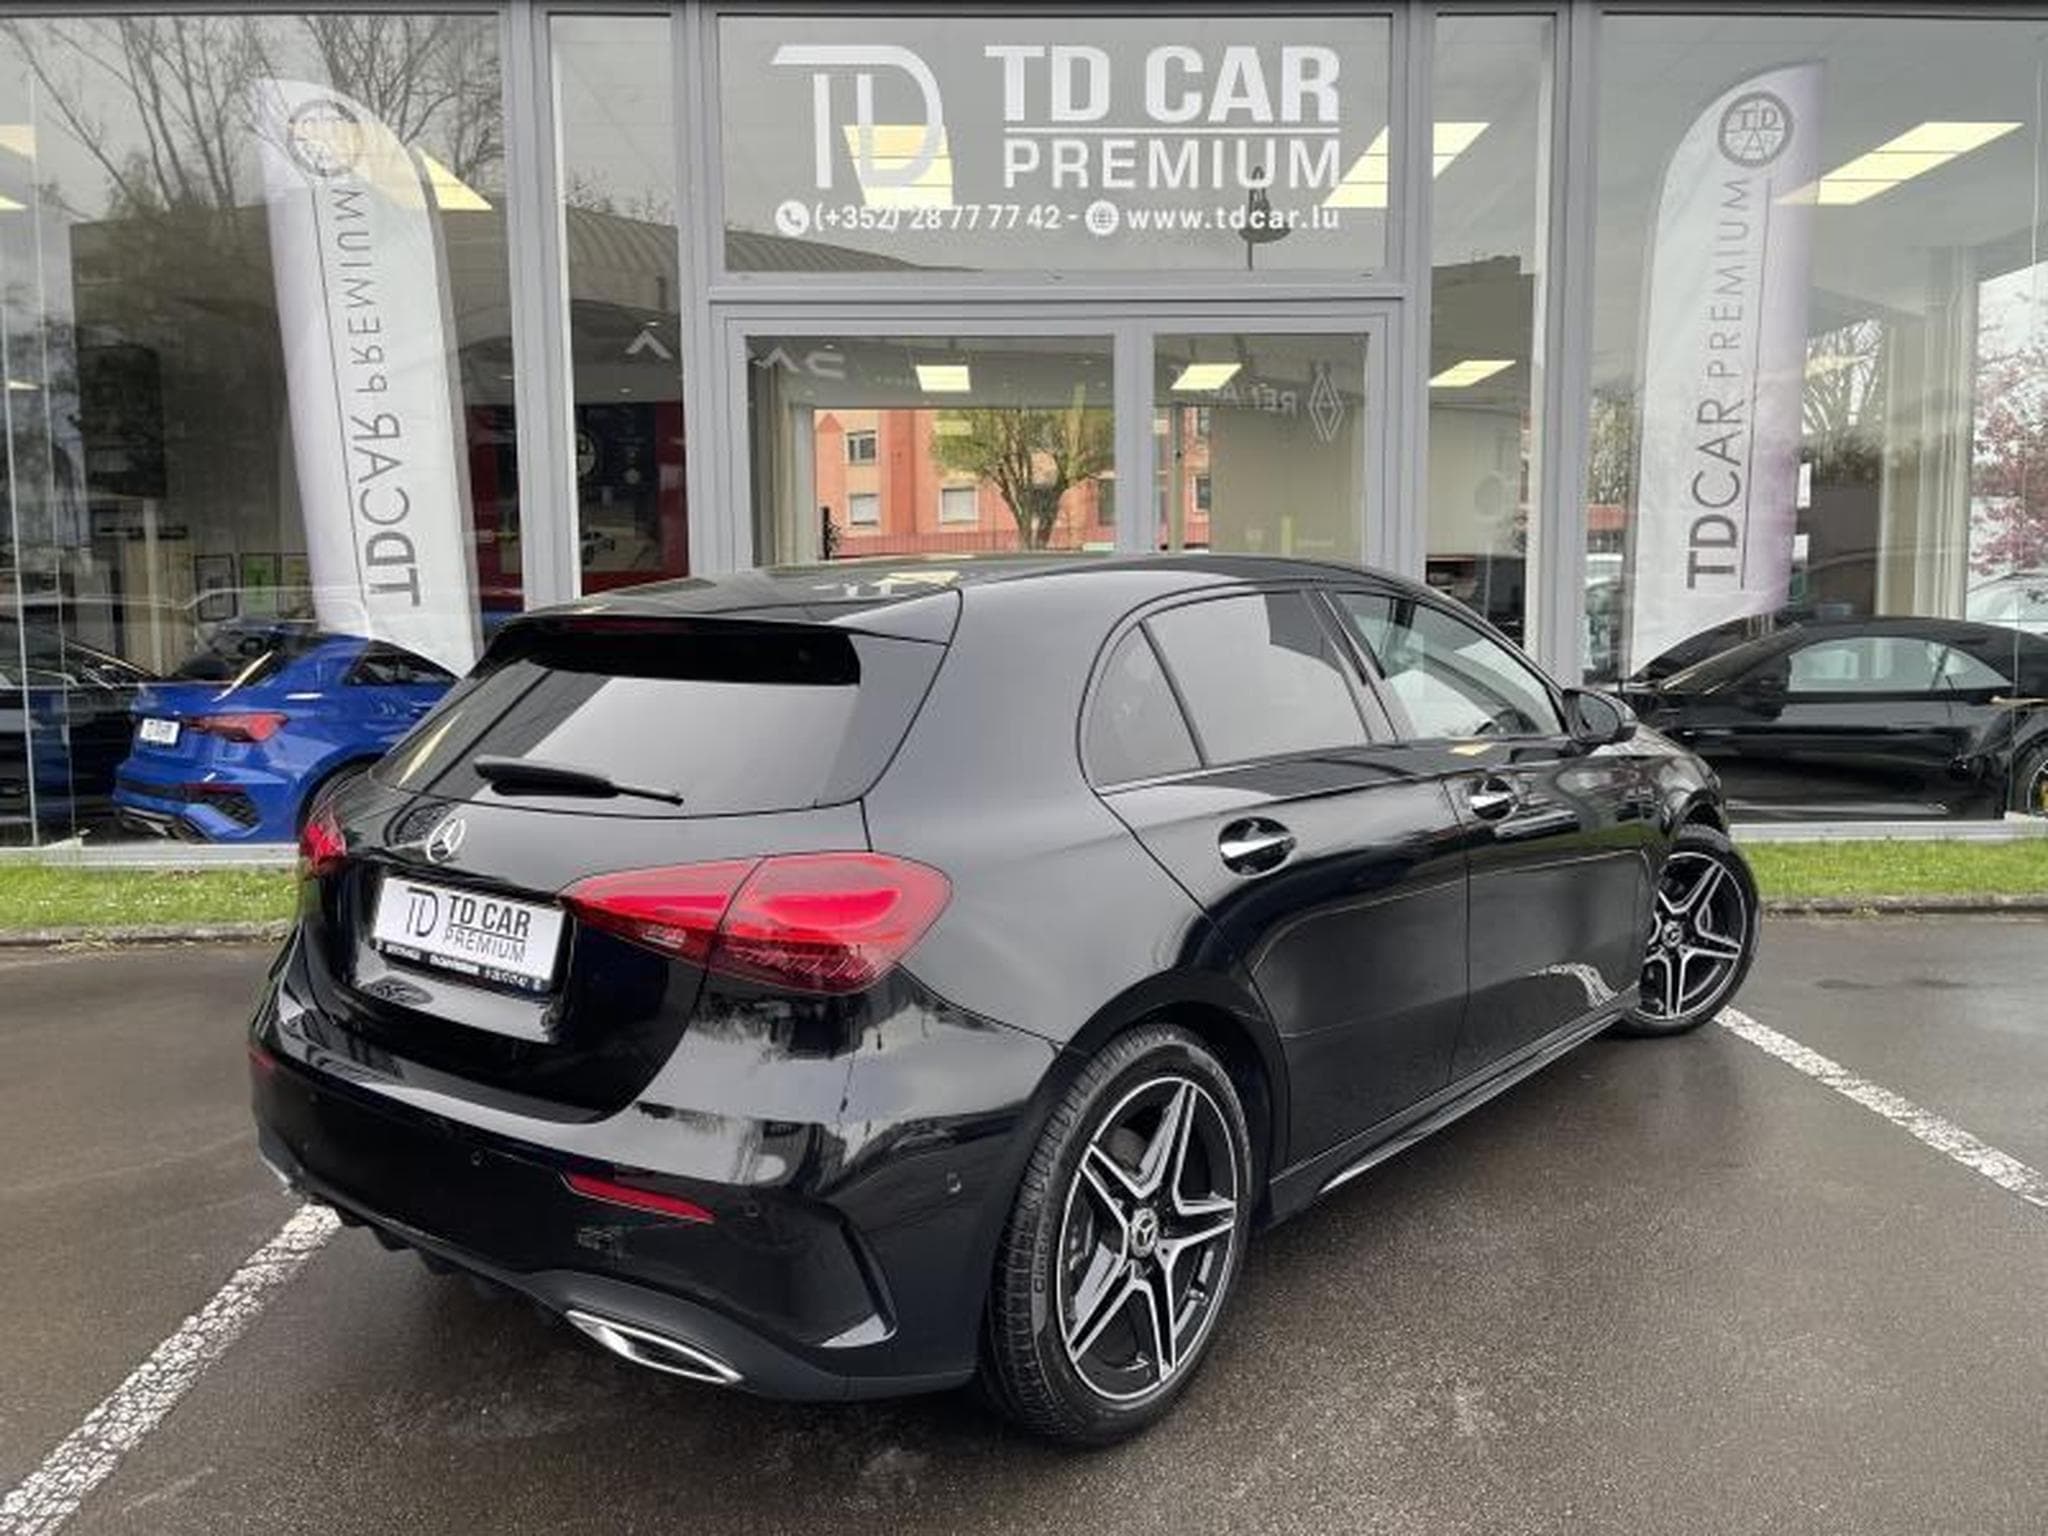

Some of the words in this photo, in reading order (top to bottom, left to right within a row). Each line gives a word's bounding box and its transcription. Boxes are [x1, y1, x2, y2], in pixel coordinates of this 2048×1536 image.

[985, 45, 1111, 122] TD
[1145, 45, 1341, 122] CAR
[1004, 138, 1341, 189] PREMIUM
[909, 205, 942, 230] 28
[951, 204, 982, 230] 77
[988, 204, 1020, 230] 77
[1026, 204, 1061, 230] 42
[1126, 204, 1340, 230] www.tdcar.lu
[1707, 178, 1751, 378] PREMIUM
[449, 894, 477, 926] TD
[480, 901, 532, 937] CAR
[443, 927, 527, 964] PREMIUM
